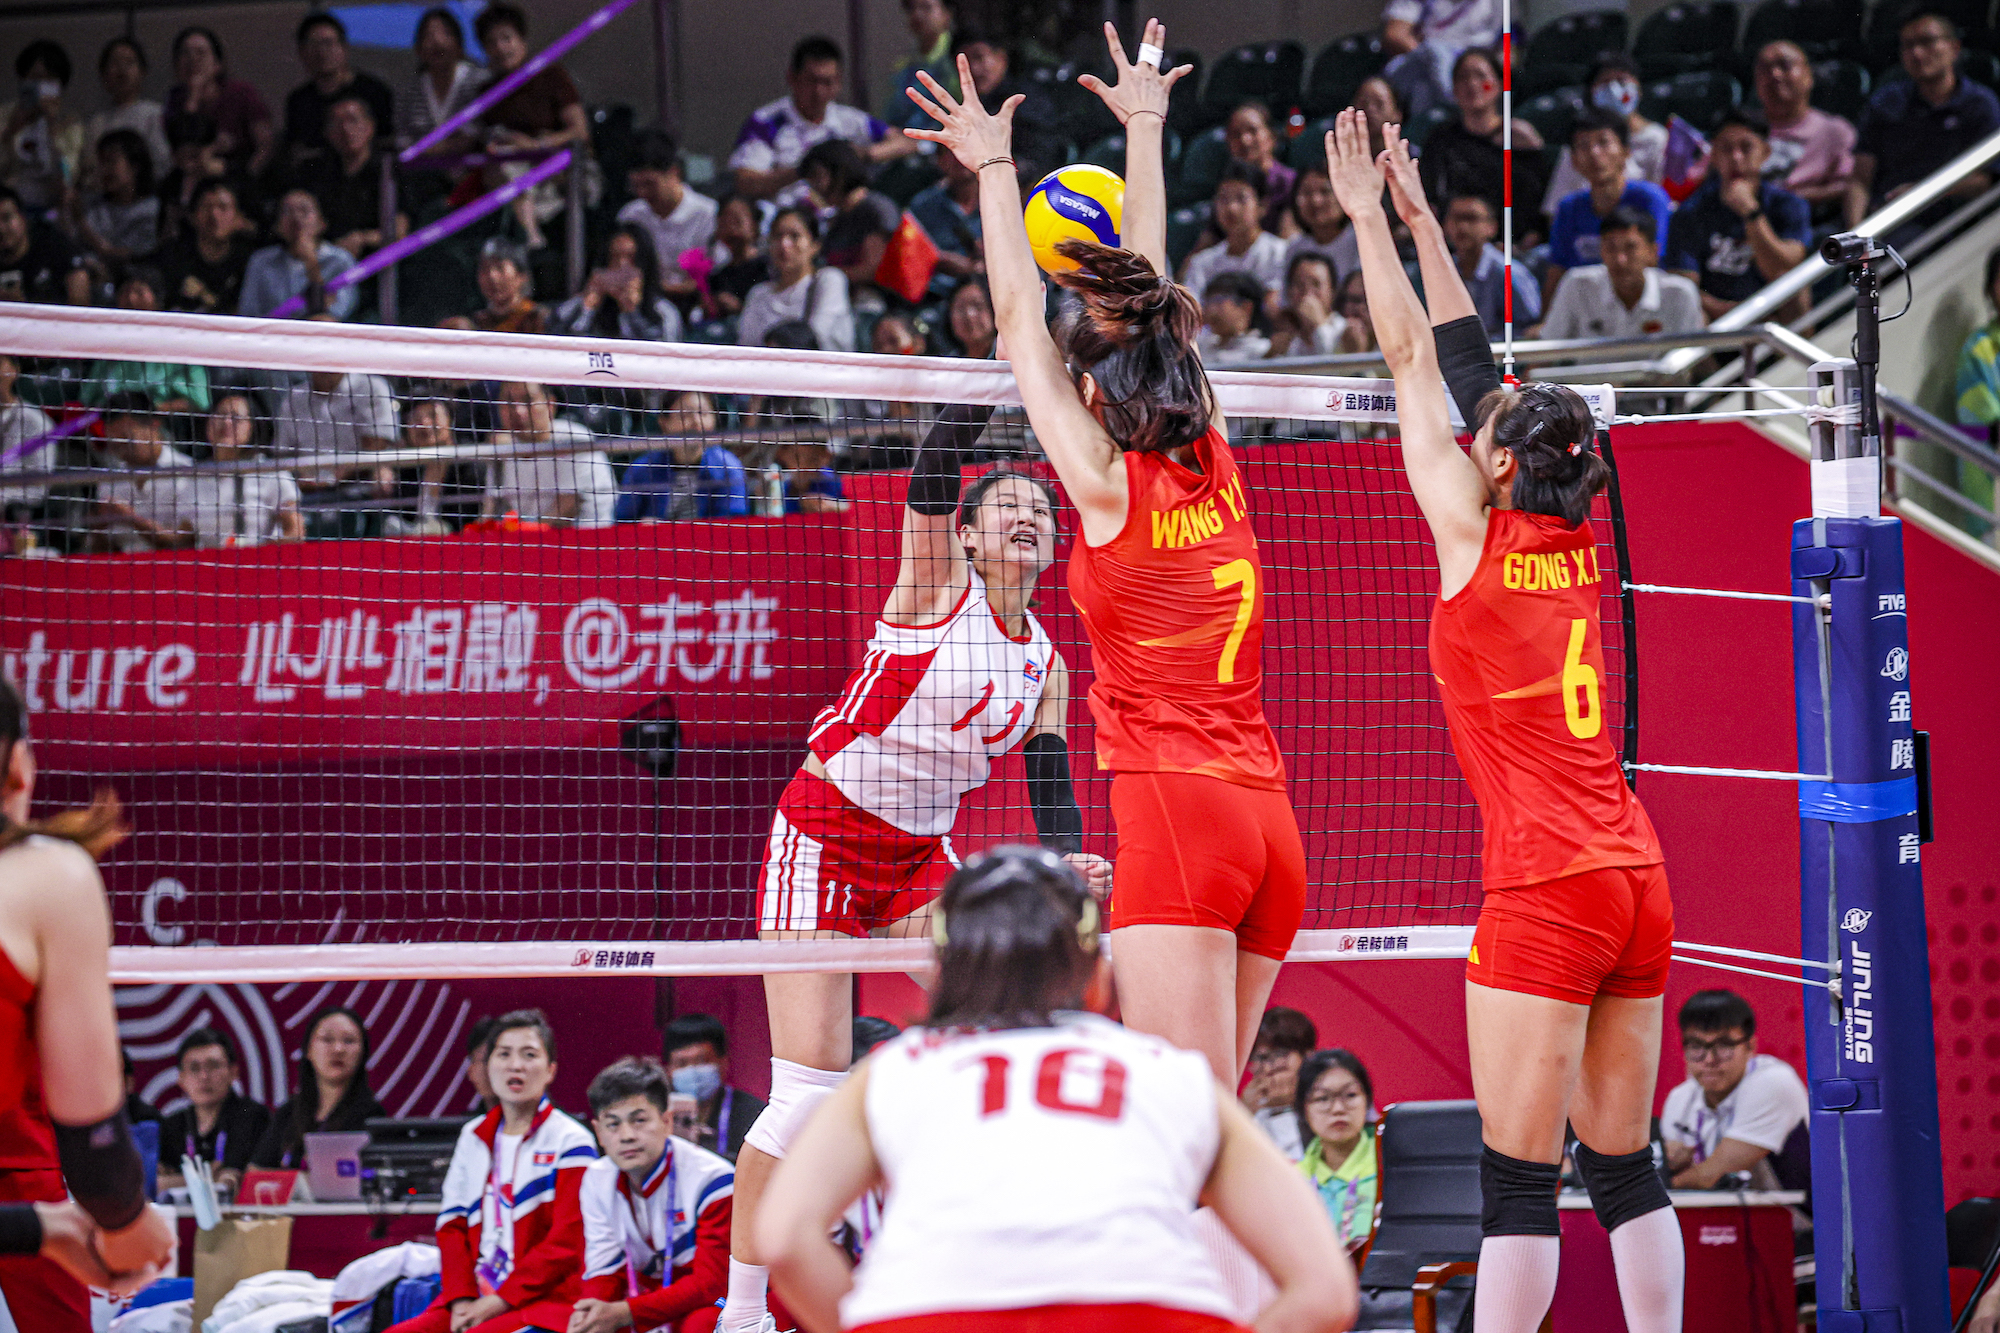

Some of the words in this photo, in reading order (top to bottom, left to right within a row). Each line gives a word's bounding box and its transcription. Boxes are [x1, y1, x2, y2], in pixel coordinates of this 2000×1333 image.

[1345, 393, 1396, 412] 金陵体育
[1151, 496, 1224, 549] WANG
[1503, 552, 1571, 591] GONG
[1211, 558, 1255, 683] 7
[1878, 594, 1906, 611] FIVB
[1562, 618, 1602, 739] 6
[950, 678, 1024, 745] 11
[1888, 691, 1920, 864] 金陵育
[825, 880, 852, 915] 11
[595, 950, 655, 967] 金陵体育
[1357, 936, 1408, 952] 金陵体育
[1851, 940, 1873, 1064] JINLING
[1844, 1006, 1854, 1061] SPORTS
[970, 1046, 1126, 1122] 10
